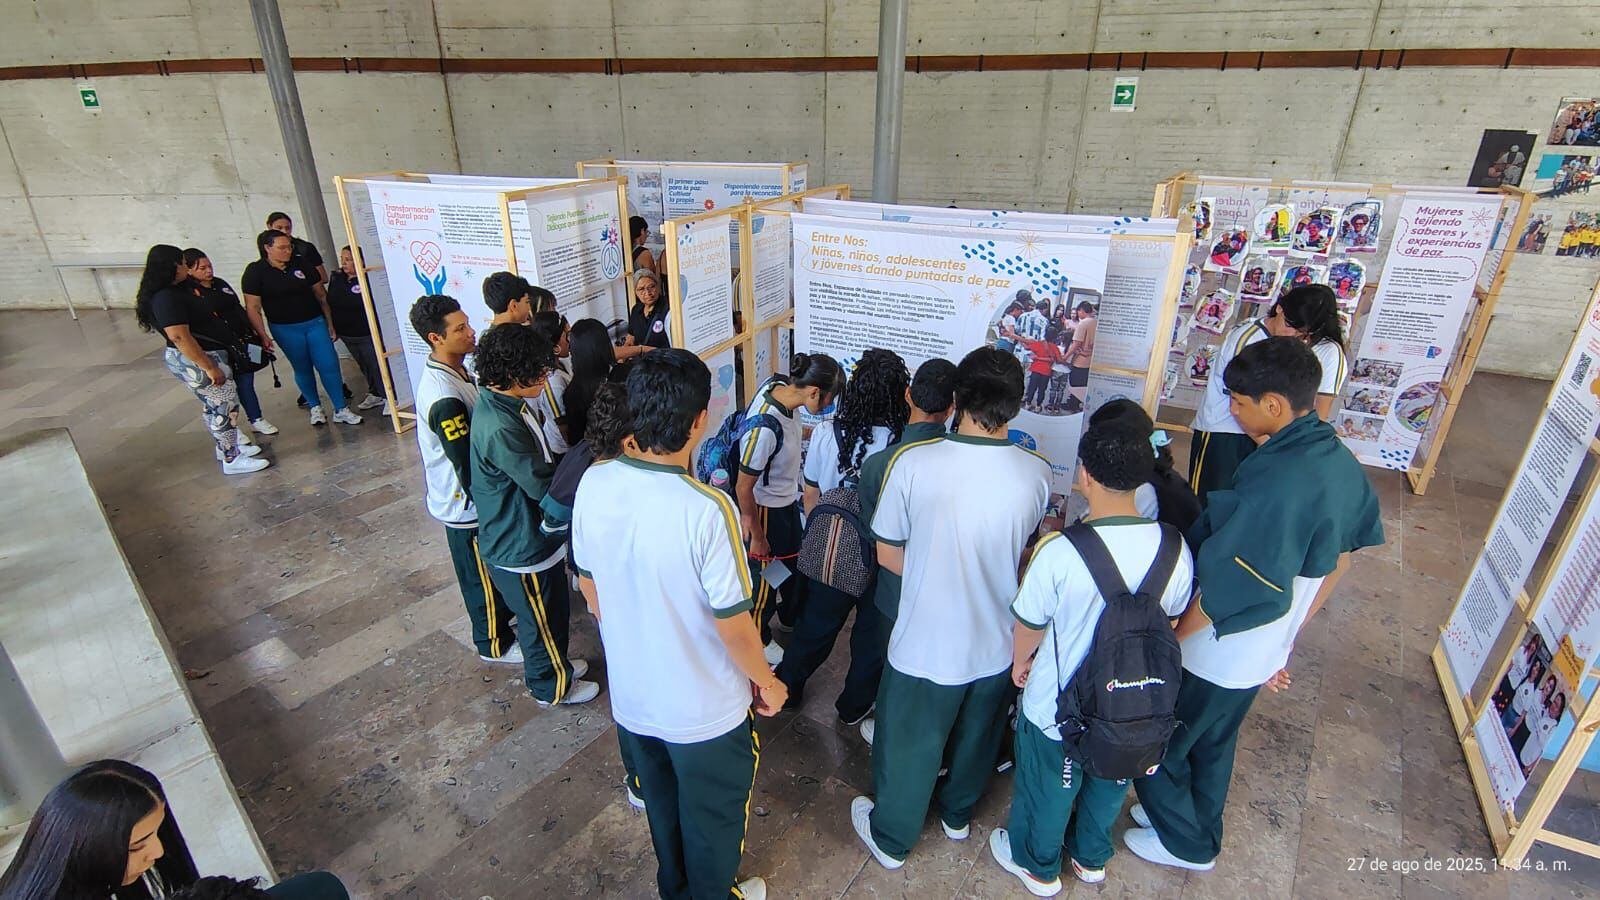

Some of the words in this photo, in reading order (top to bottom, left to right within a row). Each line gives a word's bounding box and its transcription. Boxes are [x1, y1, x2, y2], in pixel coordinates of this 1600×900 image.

[385, 204, 435, 214] Transformación
[1416, 206, 1464, 217] Mujeres
[387, 211, 412, 219] Cultural
[1414, 216, 1462, 226] tejiendo
[1410, 227, 1457, 236] saberes
[811, 232, 840, 244] Entre
[1407, 238, 1482, 249] experiencias
[812, 245, 845, 260] Niñas,
[849, 250, 882, 264] niños,
[886, 254, 966, 271] adolescentes
[1420, 249, 1444, 257] paz
[811, 260, 818, 269] y
[820, 258, 862, 273] jóvenes
[865, 264, 902, 276] dando
[905, 268, 964, 284] puntadas
[967, 274, 983, 285] de
[986, 278, 1011, 289] paz
[440, 413, 469, 441] 25
[1106, 676, 1166, 692] Champion
